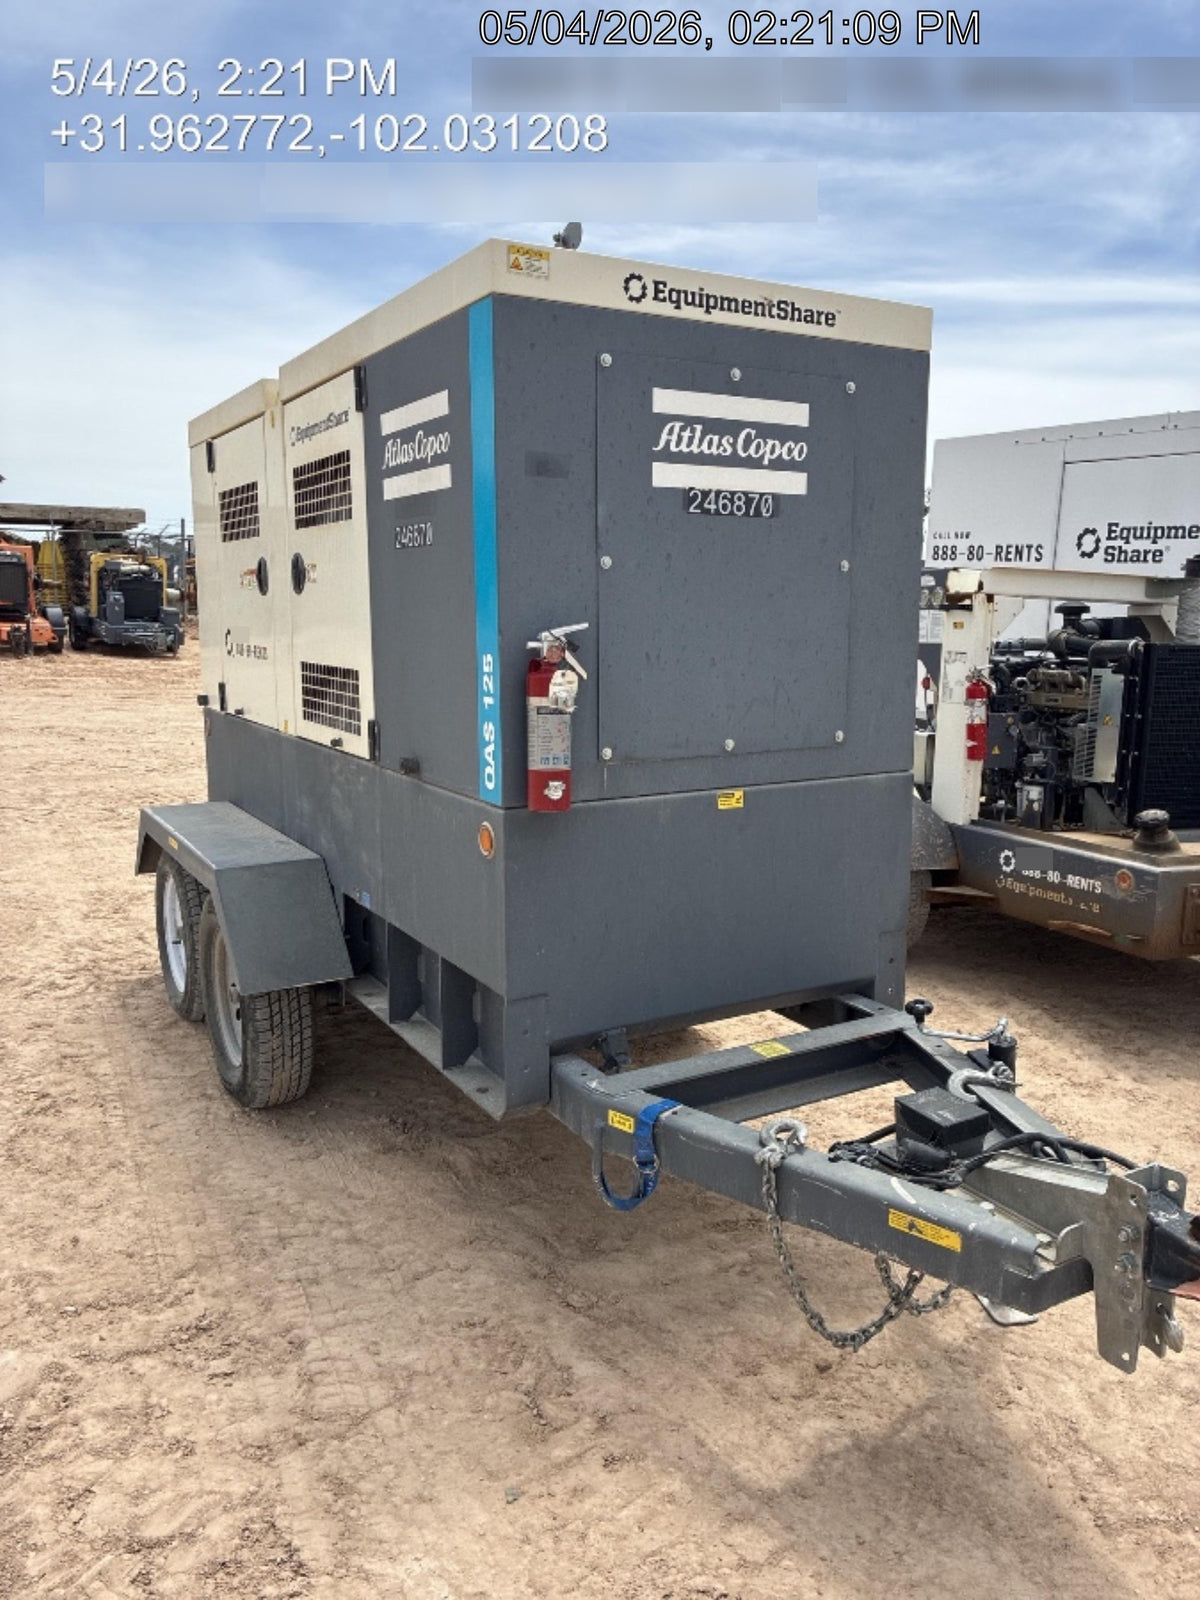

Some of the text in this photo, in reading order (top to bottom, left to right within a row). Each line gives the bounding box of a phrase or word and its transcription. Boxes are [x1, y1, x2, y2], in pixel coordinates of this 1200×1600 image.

[652, 279, 837, 328] EquipmentShare
[382, 429, 451, 470] Atlas Copco
[652, 421, 808, 466] Atlas Copco
[688, 489, 774, 517] 246870
[931, 543, 1045, 562] 888-80-RENTS
[1103, 544, 1164, 564] Share
[483, 653, 494, 709] 125
